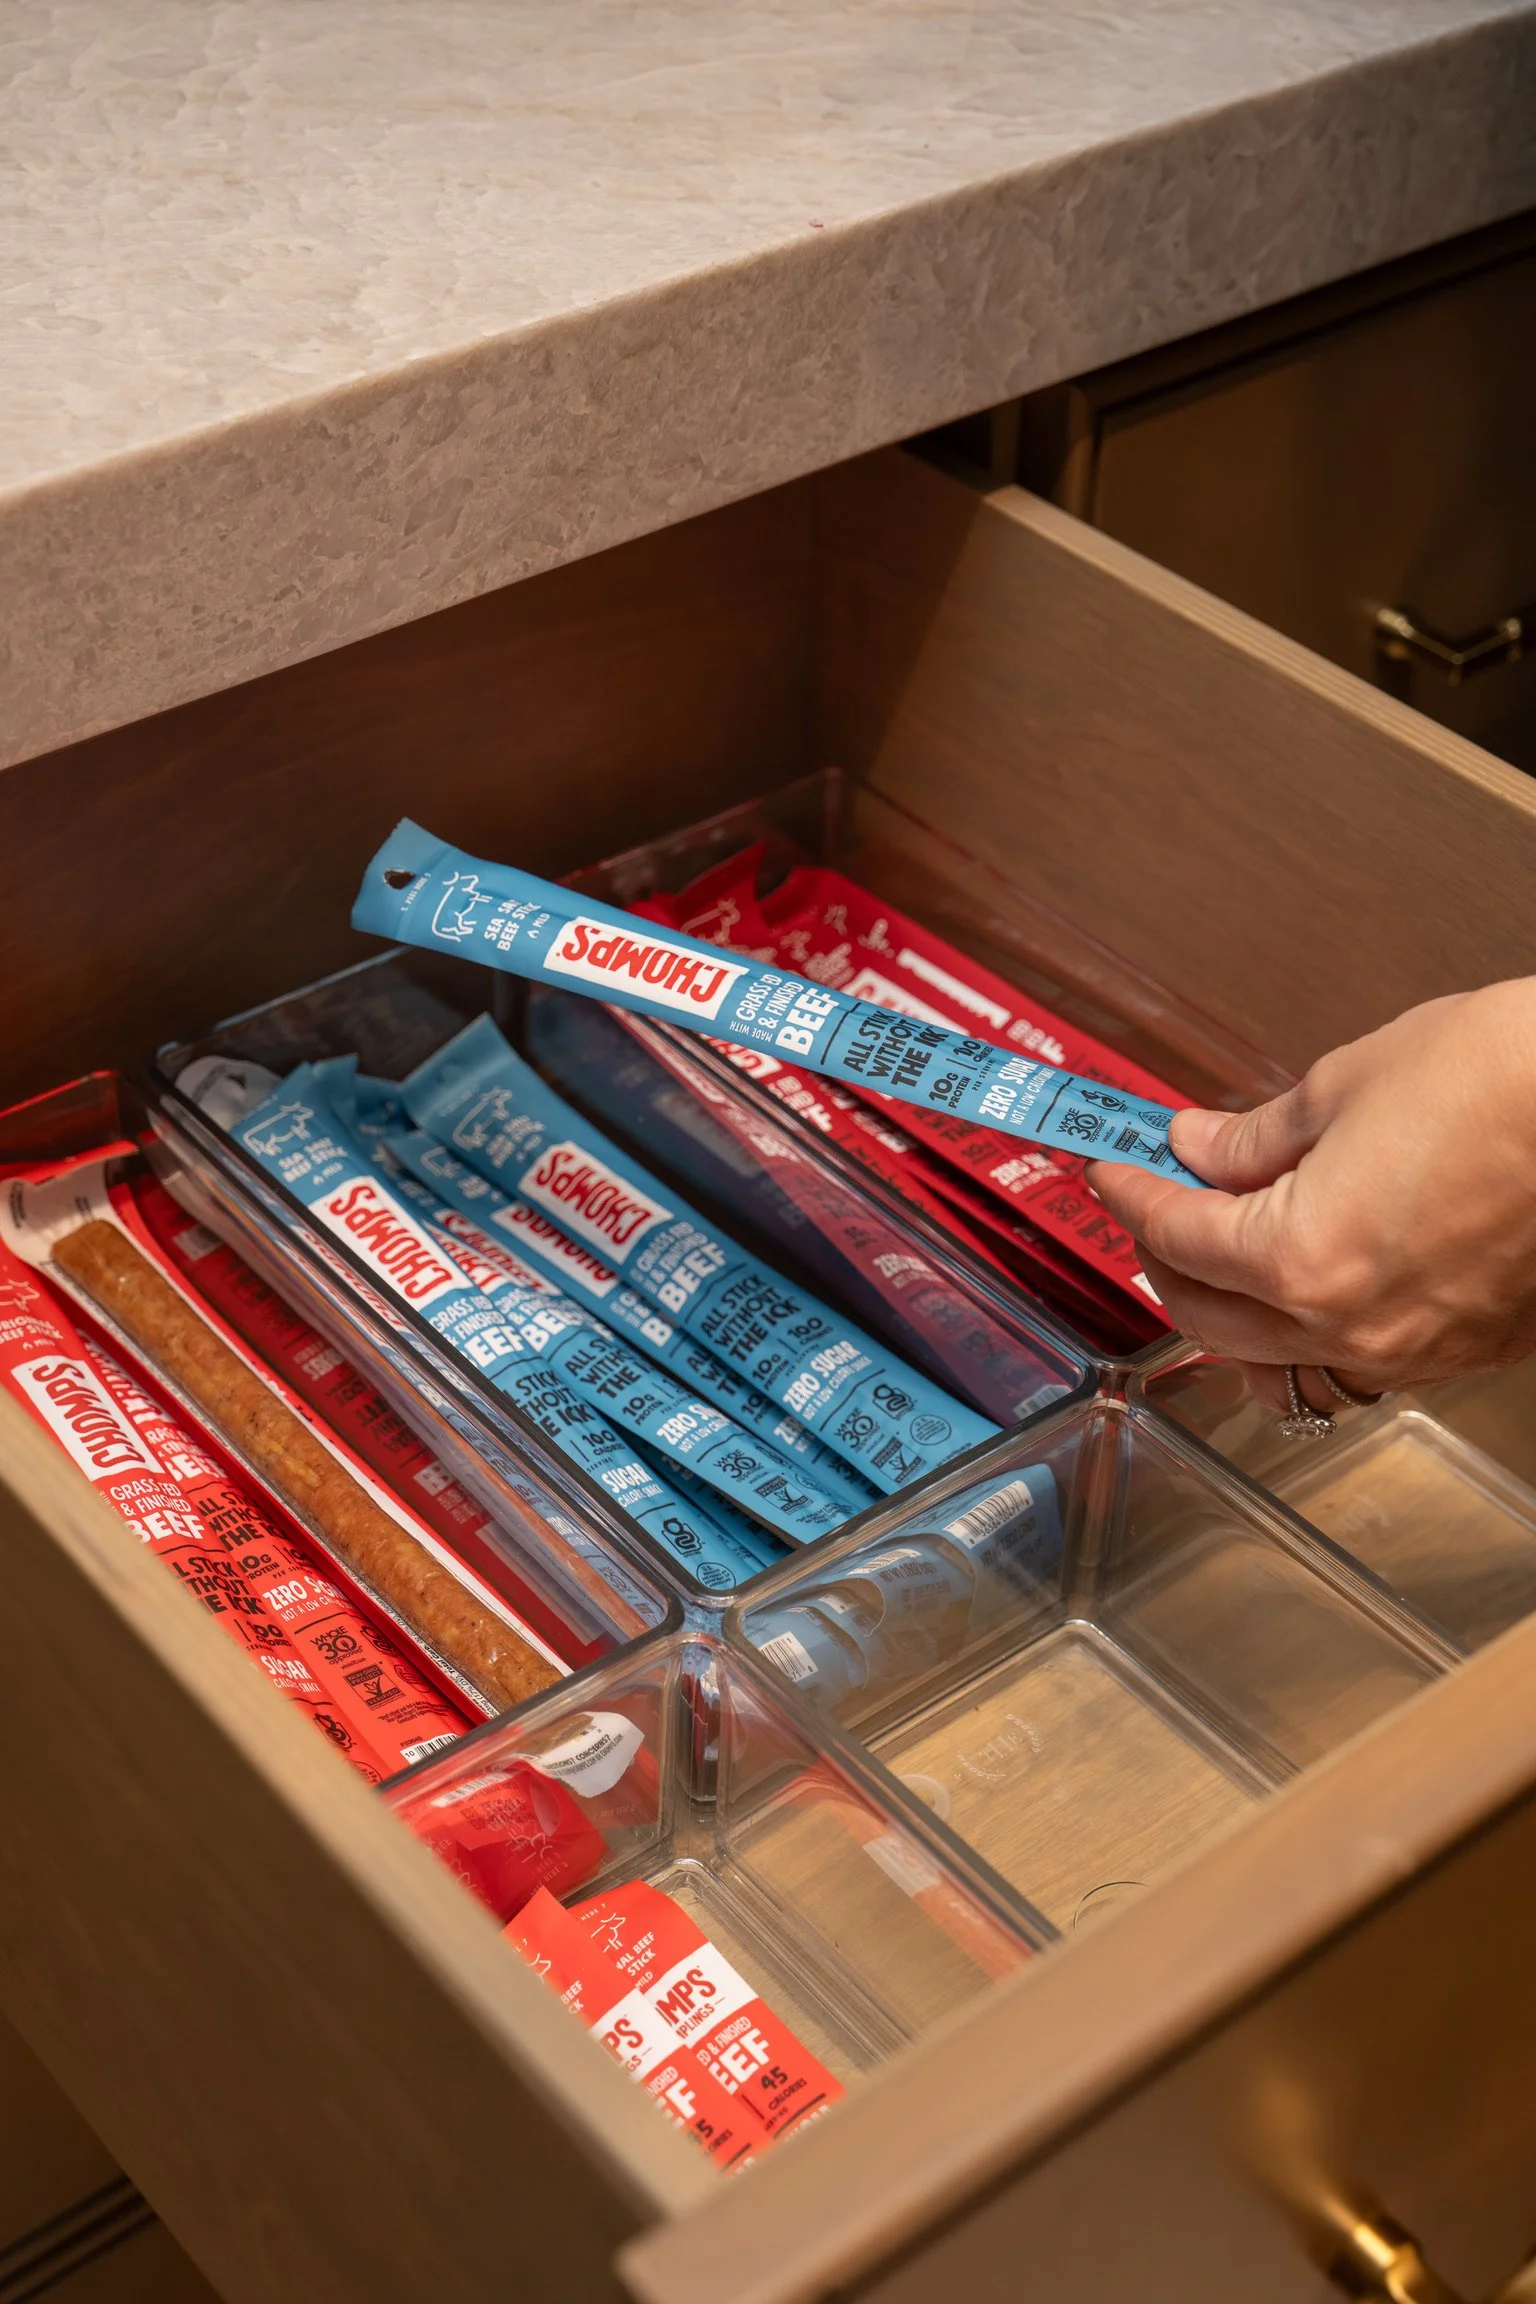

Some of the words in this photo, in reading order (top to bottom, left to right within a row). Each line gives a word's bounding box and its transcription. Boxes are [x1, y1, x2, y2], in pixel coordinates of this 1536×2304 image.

[484, 918, 505, 941] SEA
[497, 920, 520, 951] BEEF
[557, 924, 730, 1003] CHOMPS
[735, 982, 773, 1021] GRASS
[729, 1019, 750, 1036] WITH
[751, 1027, 774, 1042] MADE
[757, 1016, 779, 1029] &
[775, 987, 840, 1055] BEEF
[842, 1041, 875, 1073] ALL
[890, 1047, 932, 1087] THE
[928, 1072, 959, 1102] 10G
[947, 1076, 972, 1109] PROTEIN
[971, 1080, 981, 1091] PER
[978, 1084, 1018, 1121] ZERO
[1009, 1110, 1024, 1126] NOT
[1023, 1092, 1037, 1107] LOW
[1067, 1113, 1099, 1141] 30
[535, 1149, 654, 1245] CHOMPS
[324, 1183, 455, 1300] CHOMPS
[657, 1242, 727, 1314] BEEF
[429, 1298, 475, 1333] GRASS
[699, 1308, 729, 1338] ALL
[720, 1273, 768, 1309] STICK
[729, 1322, 769, 1362] THE
[761, 1296, 802, 1326] ICK
[459, 1324, 524, 1368] EEF
[564, 1349, 597, 1376] ALL
[782, 1372, 820, 1412] ZERO
[810, 1340, 861, 1378] SUGAR
[515, 1369, 564, 1397] STICK
[596, 1366, 642, 1399] THE
[28, 1362, 147, 1469] CHOMPS
[514, 1387, 578, 1421] THOUT
[556, 1403, 596, 1426] ICK
[802, 1405, 819, 1422] NOT
[581, 1429, 617, 1448] 100
[656, 1412, 698, 1446] ZERO
[678, 1438, 696, 1454] NOT
[691, 1433, 700, 1443] A
[841, 1414, 874, 1448] 30
[601, 1462, 653, 1494] SUGAR
[722, 1456, 757, 1479] 30
[110, 1479, 160, 1501] GRASS
[120, 1502, 137, 1517] &
[137, 1496, 191, 1517] FINISHED
[188, 1556, 239, 1578] STICK
[183, 1575, 251, 1598] THOUT
[262, 1580, 308, 1611] ZERO
[281, 1607, 298, 1623] NOT
[299, 1605, 306, 1614] A
[304, 1600, 320, 1612] LOW
[310, 1625, 349, 1646] WHOLE
[317, 1635, 357, 1661] 30
[260, 1655, 313, 1680] SUGAR
[350, 1670, 384, 1687] PROJECT
[439, 1658, 455, 1675] Total
[366, 1687, 401, 1707] VERIFIED
[575, 1734, 612, 1761] CONCERNS?
[580, 1909, 599, 1921] HERE
[633, 1931, 656, 1955] BEEF
[627, 1948, 656, 1977] STICK
[655, 1968, 717, 2027] MPS
[707, 2042, 721, 2056] &
[714, 2016, 752, 2048] FINISHED
[760, 2066, 788, 2092] 45
[768, 2077, 808, 2111] CALORIES
